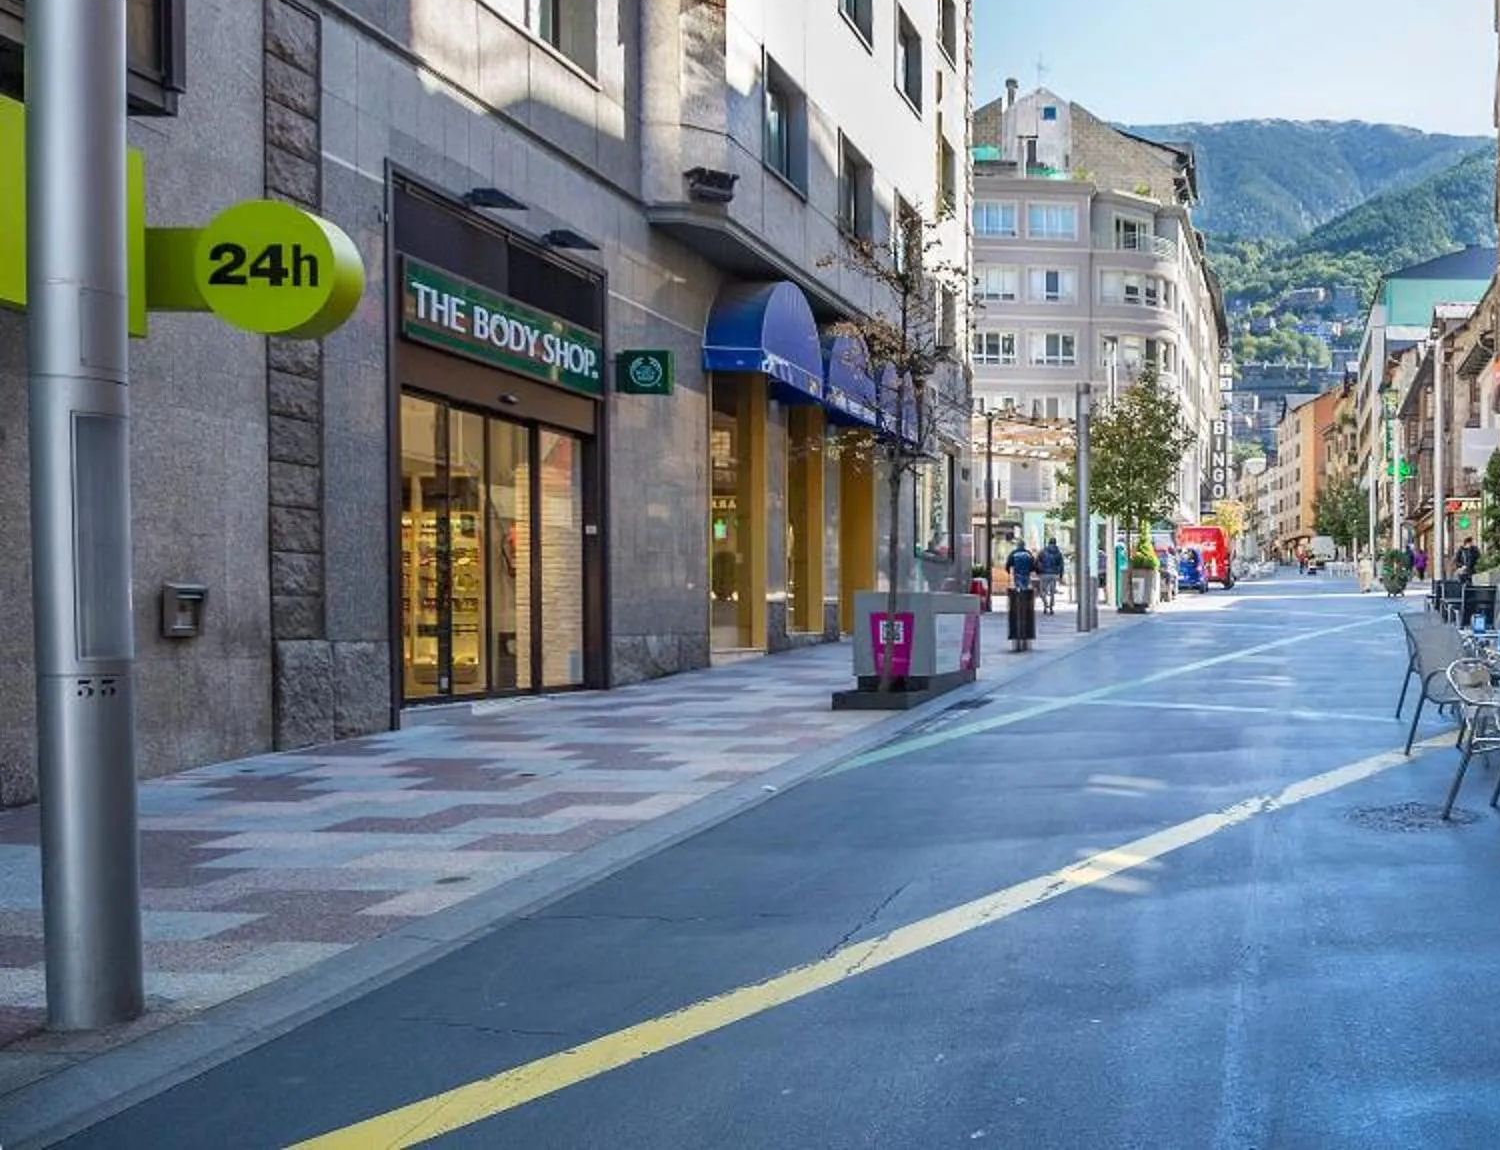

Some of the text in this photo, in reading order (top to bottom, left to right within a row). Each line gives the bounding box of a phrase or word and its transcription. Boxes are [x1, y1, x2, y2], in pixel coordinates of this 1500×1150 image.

[207, 242, 319, 287] 24h
[411, 281, 467, 334] THE
[473, 304, 542, 358] BODY
[1212, 421, 1226, 499] BINGO
